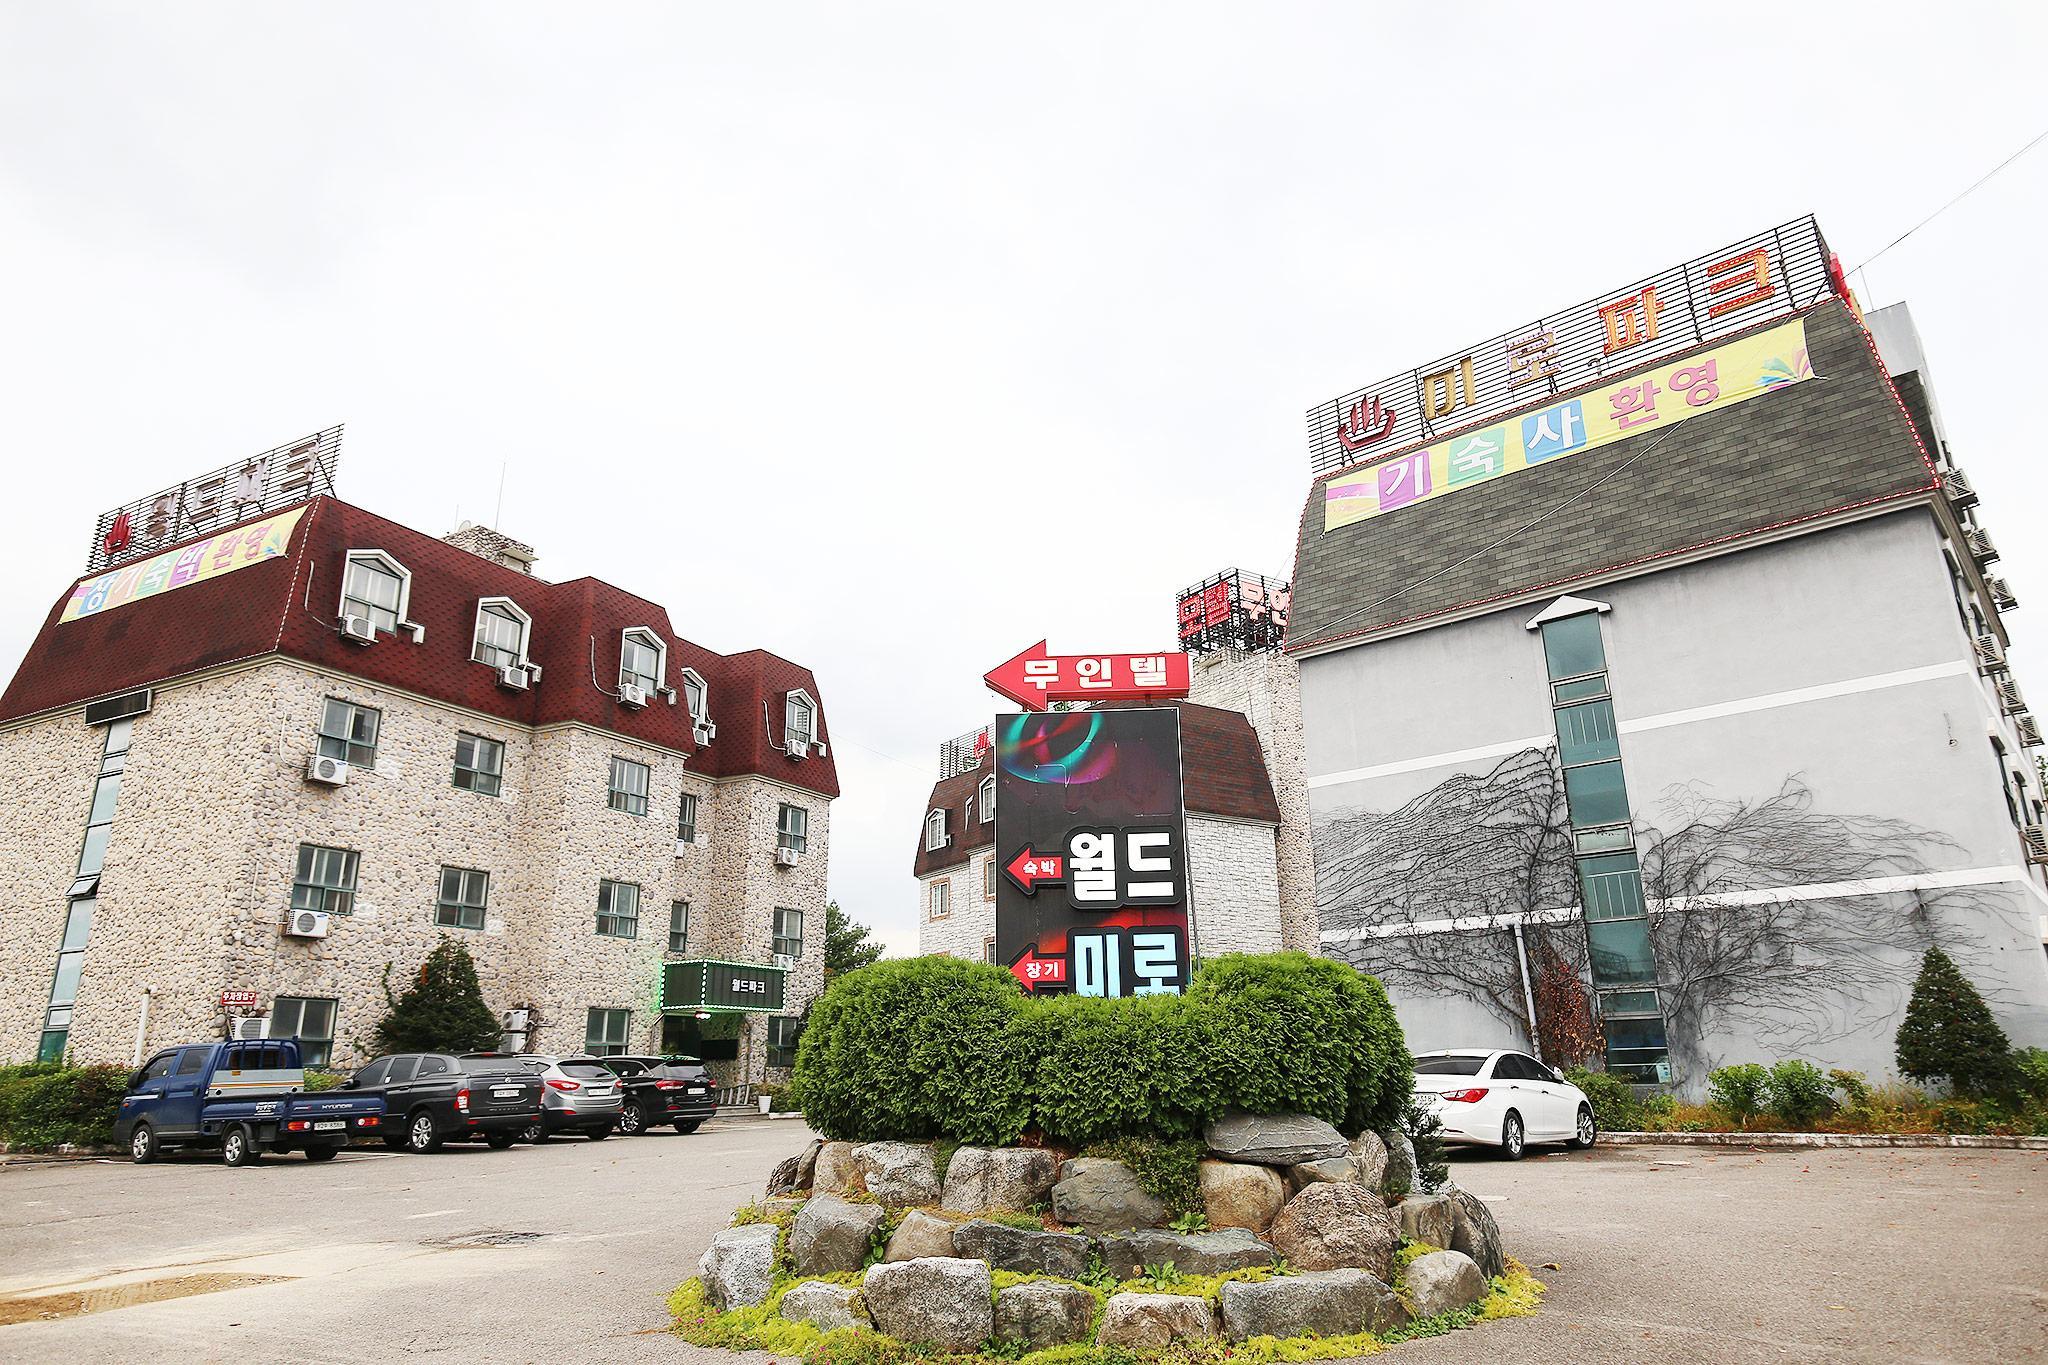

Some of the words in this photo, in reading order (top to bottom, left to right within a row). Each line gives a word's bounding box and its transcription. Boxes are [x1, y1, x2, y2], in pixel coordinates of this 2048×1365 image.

[1424, 248, 1776, 420] 미로파크
[1384, 409, 1582, 497] 기숙사
[1608, 359, 1722, 430] 환영
[212, 523, 275, 571] 환영
[1179, 580, 1231, 639] 모텔
[1023, 656, 1168, 690] 무인텔
[1022, 858, 1056, 876] 숙박
[1068, 832, 1175, 902] 월드
[731, 978, 766, 994] 월드파크
[1025, 961, 1060, 979] 장기
[1073, 933, 1181, 998] 미로
